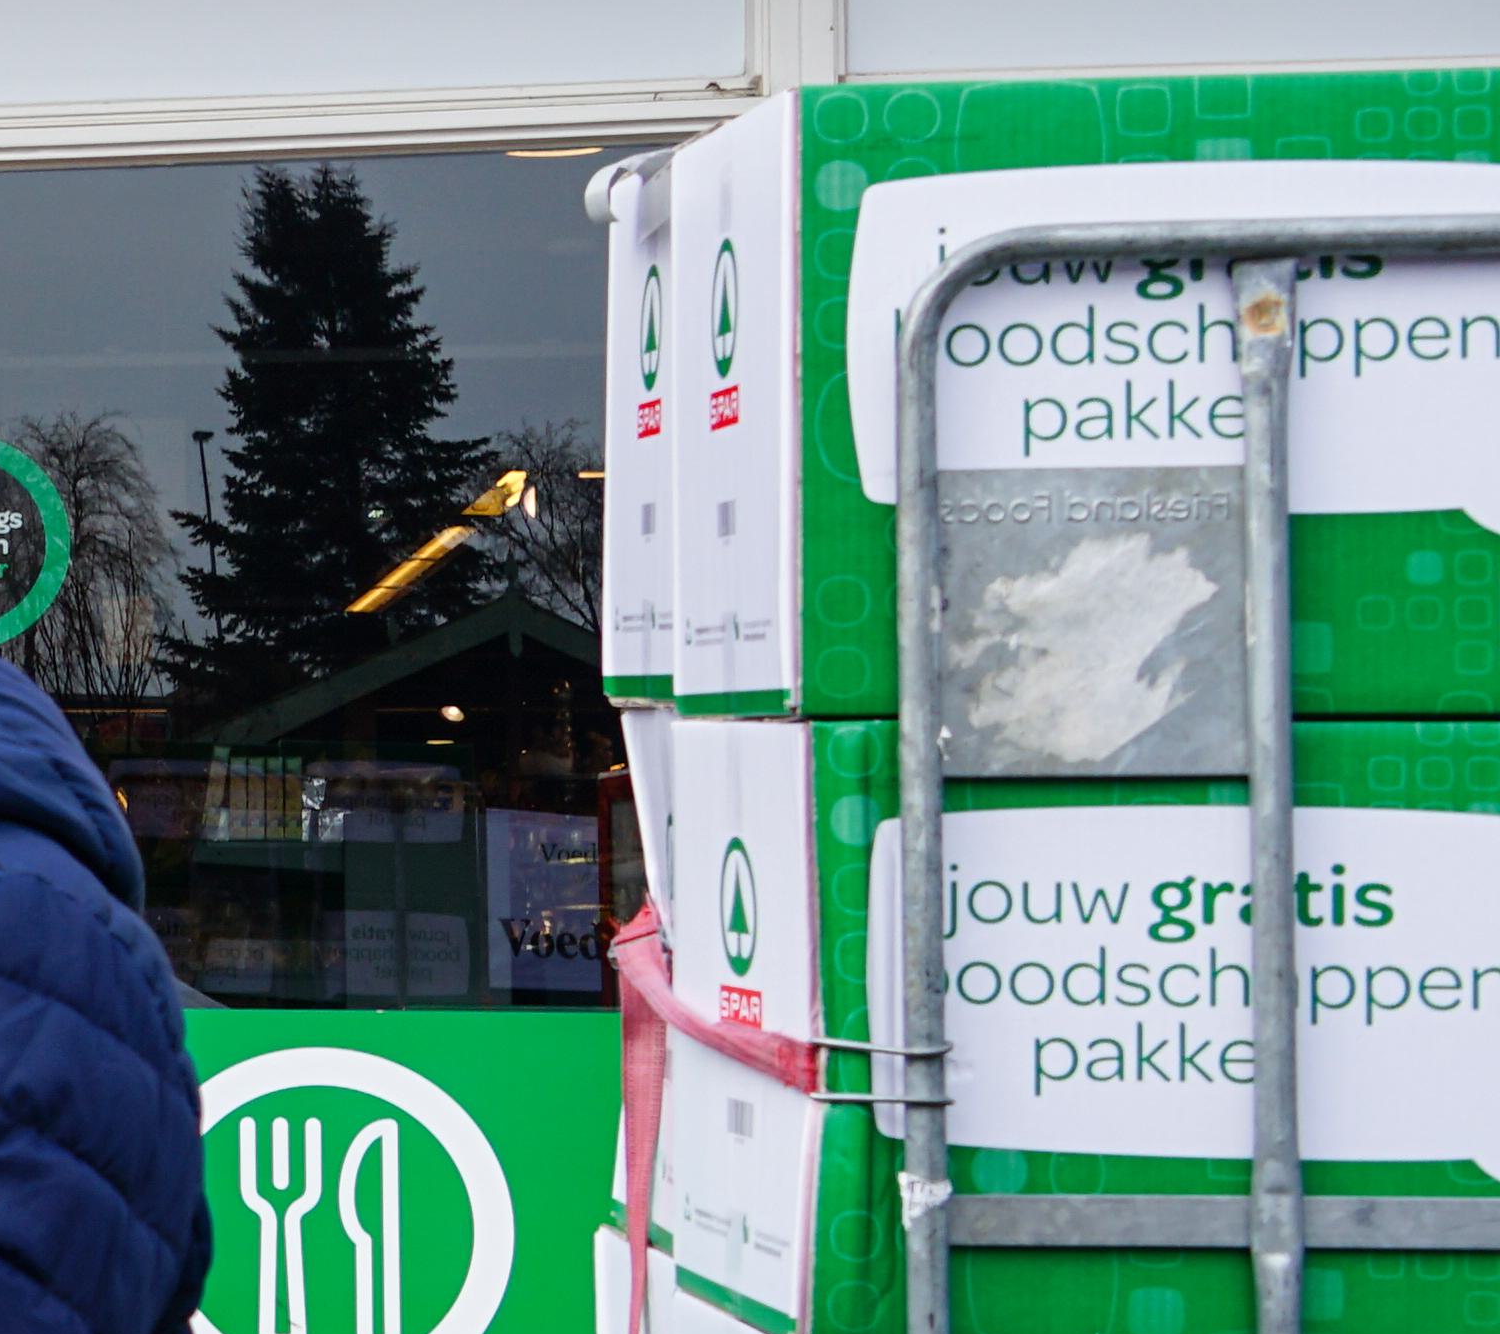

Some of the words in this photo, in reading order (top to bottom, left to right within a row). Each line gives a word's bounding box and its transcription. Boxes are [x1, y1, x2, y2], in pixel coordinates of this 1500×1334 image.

[895, 303, 1500, 378] oodschppen
[711, 389, 739, 427] SPAR
[1022, 379, 1247, 457] pakke
[942, 864, 1129, 939] jouw
[721, 989, 762, 1022] SPAR
[942, 946, 1500, 1026] oodschppen
[1034, 1022, 1255, 1097] pakke
